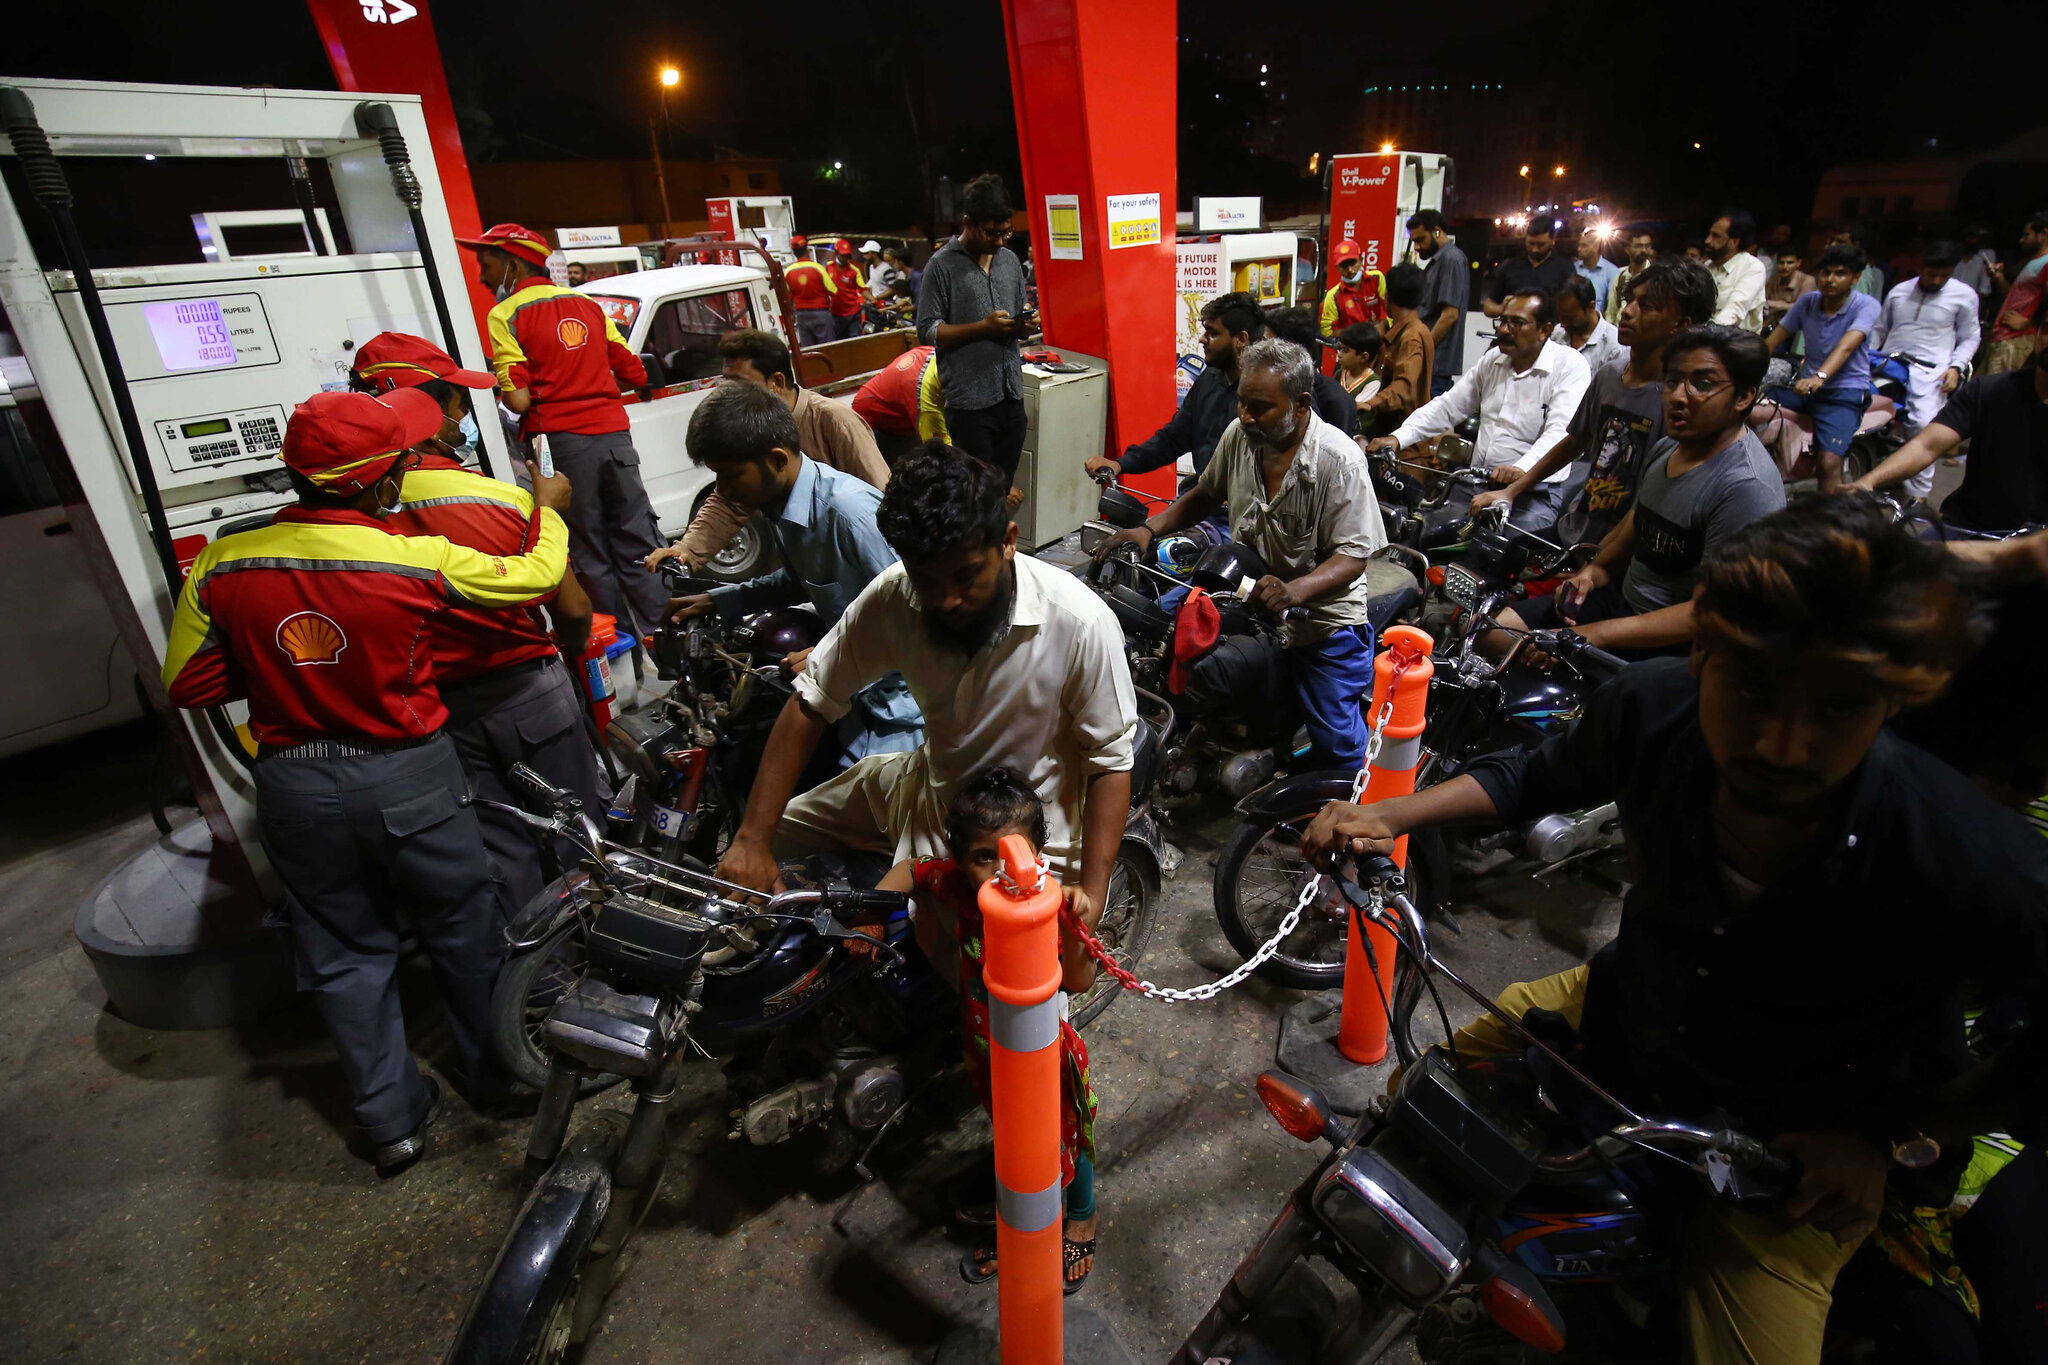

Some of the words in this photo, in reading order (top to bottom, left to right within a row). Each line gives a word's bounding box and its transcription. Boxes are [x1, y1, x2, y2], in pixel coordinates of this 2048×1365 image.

[1341, 167, 1359, 176] Shell
[1341, 176, 1387, 187] V-Power
[1109, 199, 1120, 209] For
[1121, 200, 1137, 210] your
[1138, 196, 1159, 207] safety
[1185, 254, 1217, 264] FUTURE
[1183, 267, 1217, 276] MOTOR
[1184, 280, 1192, 288] IS
[1196, 279, 1217, 288] HERE
[222, 306, 251, 315] RUPEES
[230, 327, 255, 336] LITRES
[1382, 470, 1405, 491] RAO
